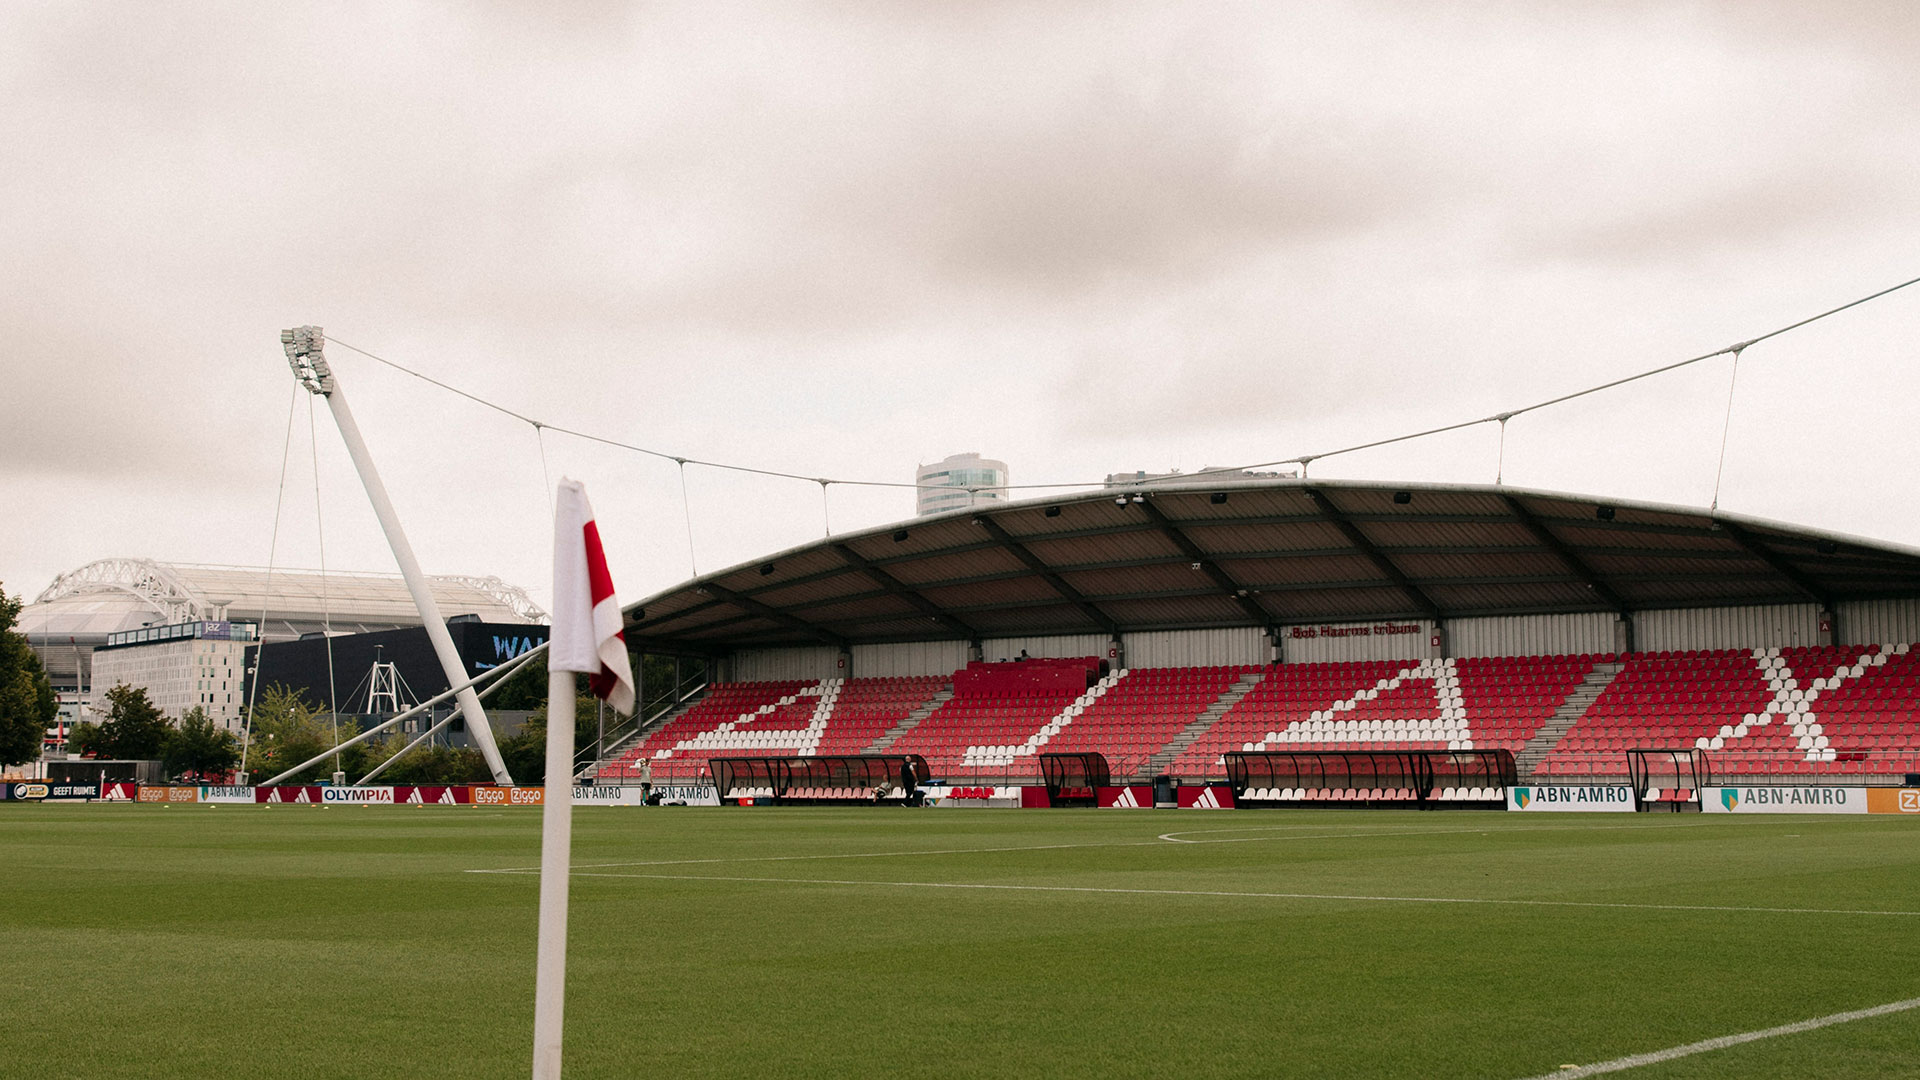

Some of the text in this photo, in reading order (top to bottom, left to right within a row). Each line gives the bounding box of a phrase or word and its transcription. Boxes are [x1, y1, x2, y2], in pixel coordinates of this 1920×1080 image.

[1292, 622, 1421, 639] Bob Haarms tribune
[53, 786, 72, 796] GEEFT
[73, 786, 96, 796] RUIMTE
[324, 789, 391, 801] OLYMPIA
